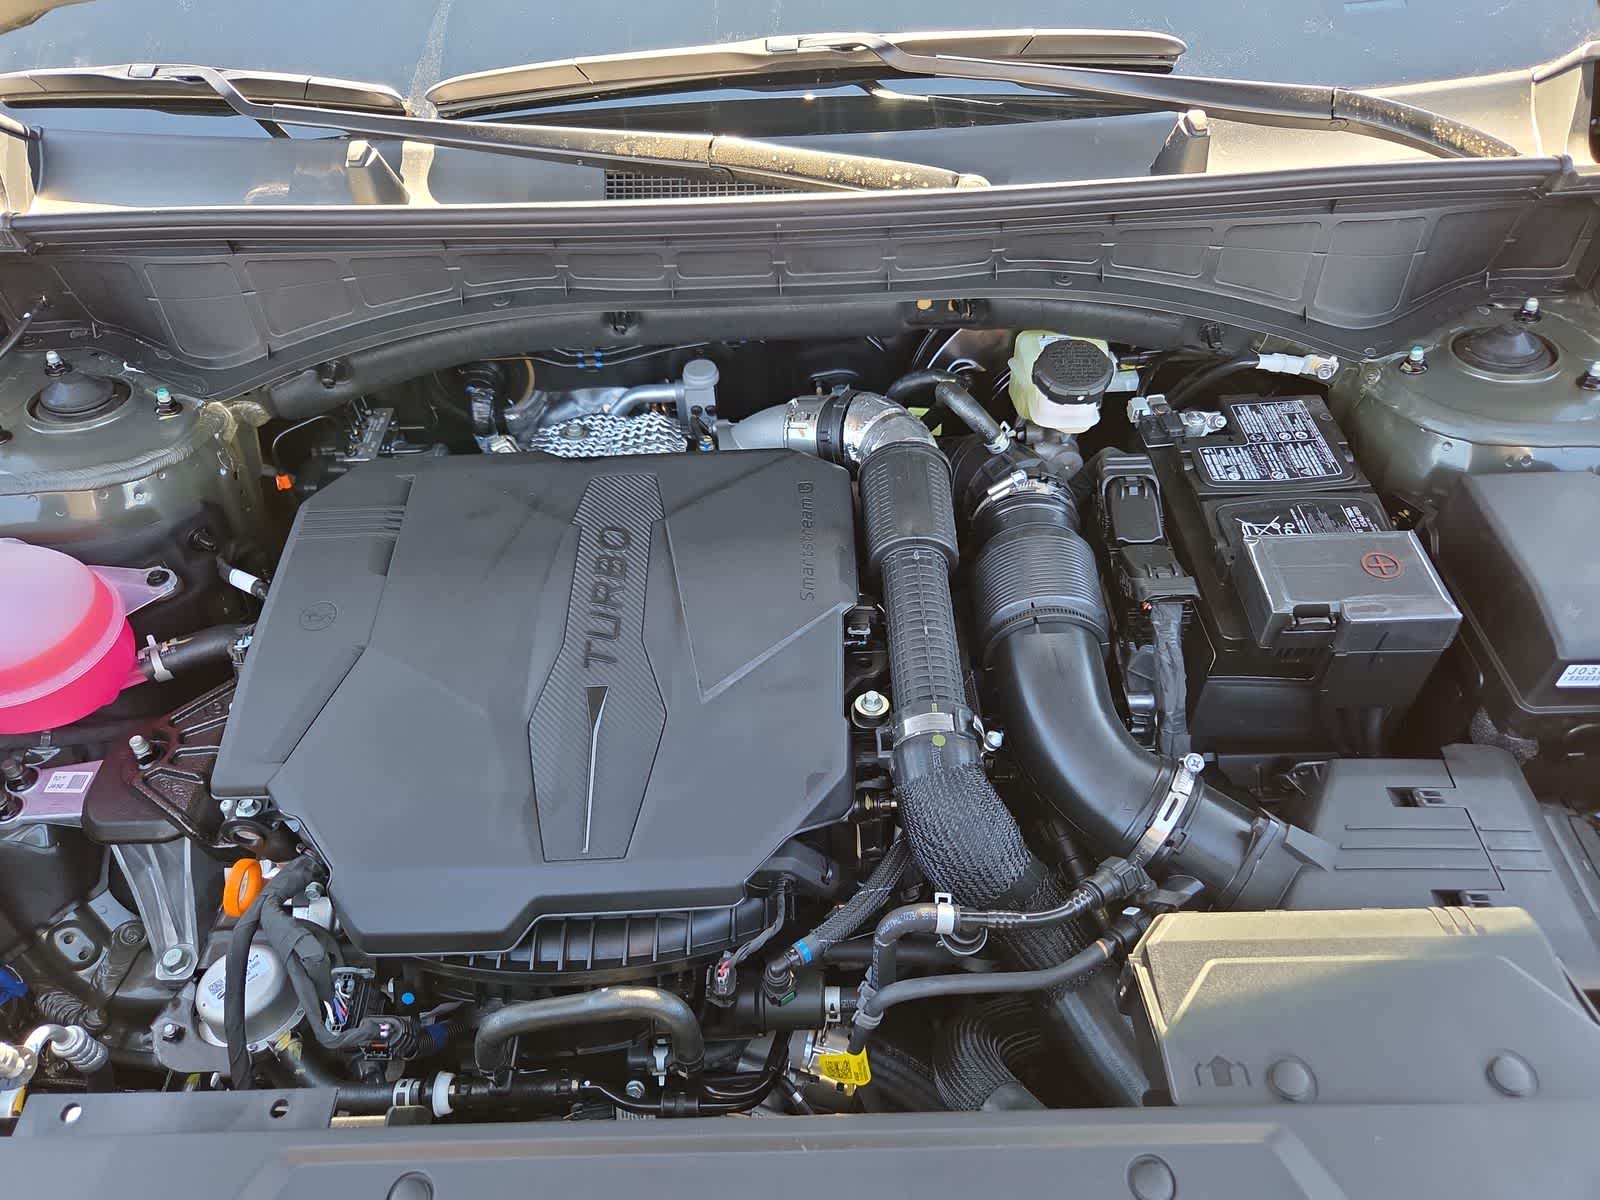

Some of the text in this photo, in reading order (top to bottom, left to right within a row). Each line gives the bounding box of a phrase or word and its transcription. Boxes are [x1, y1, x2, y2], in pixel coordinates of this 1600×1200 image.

[799, 497, 816, 601] Smartstream
[1284, 522, 1299, 536] Pb
[583, 527, 631, 668] TURBO
